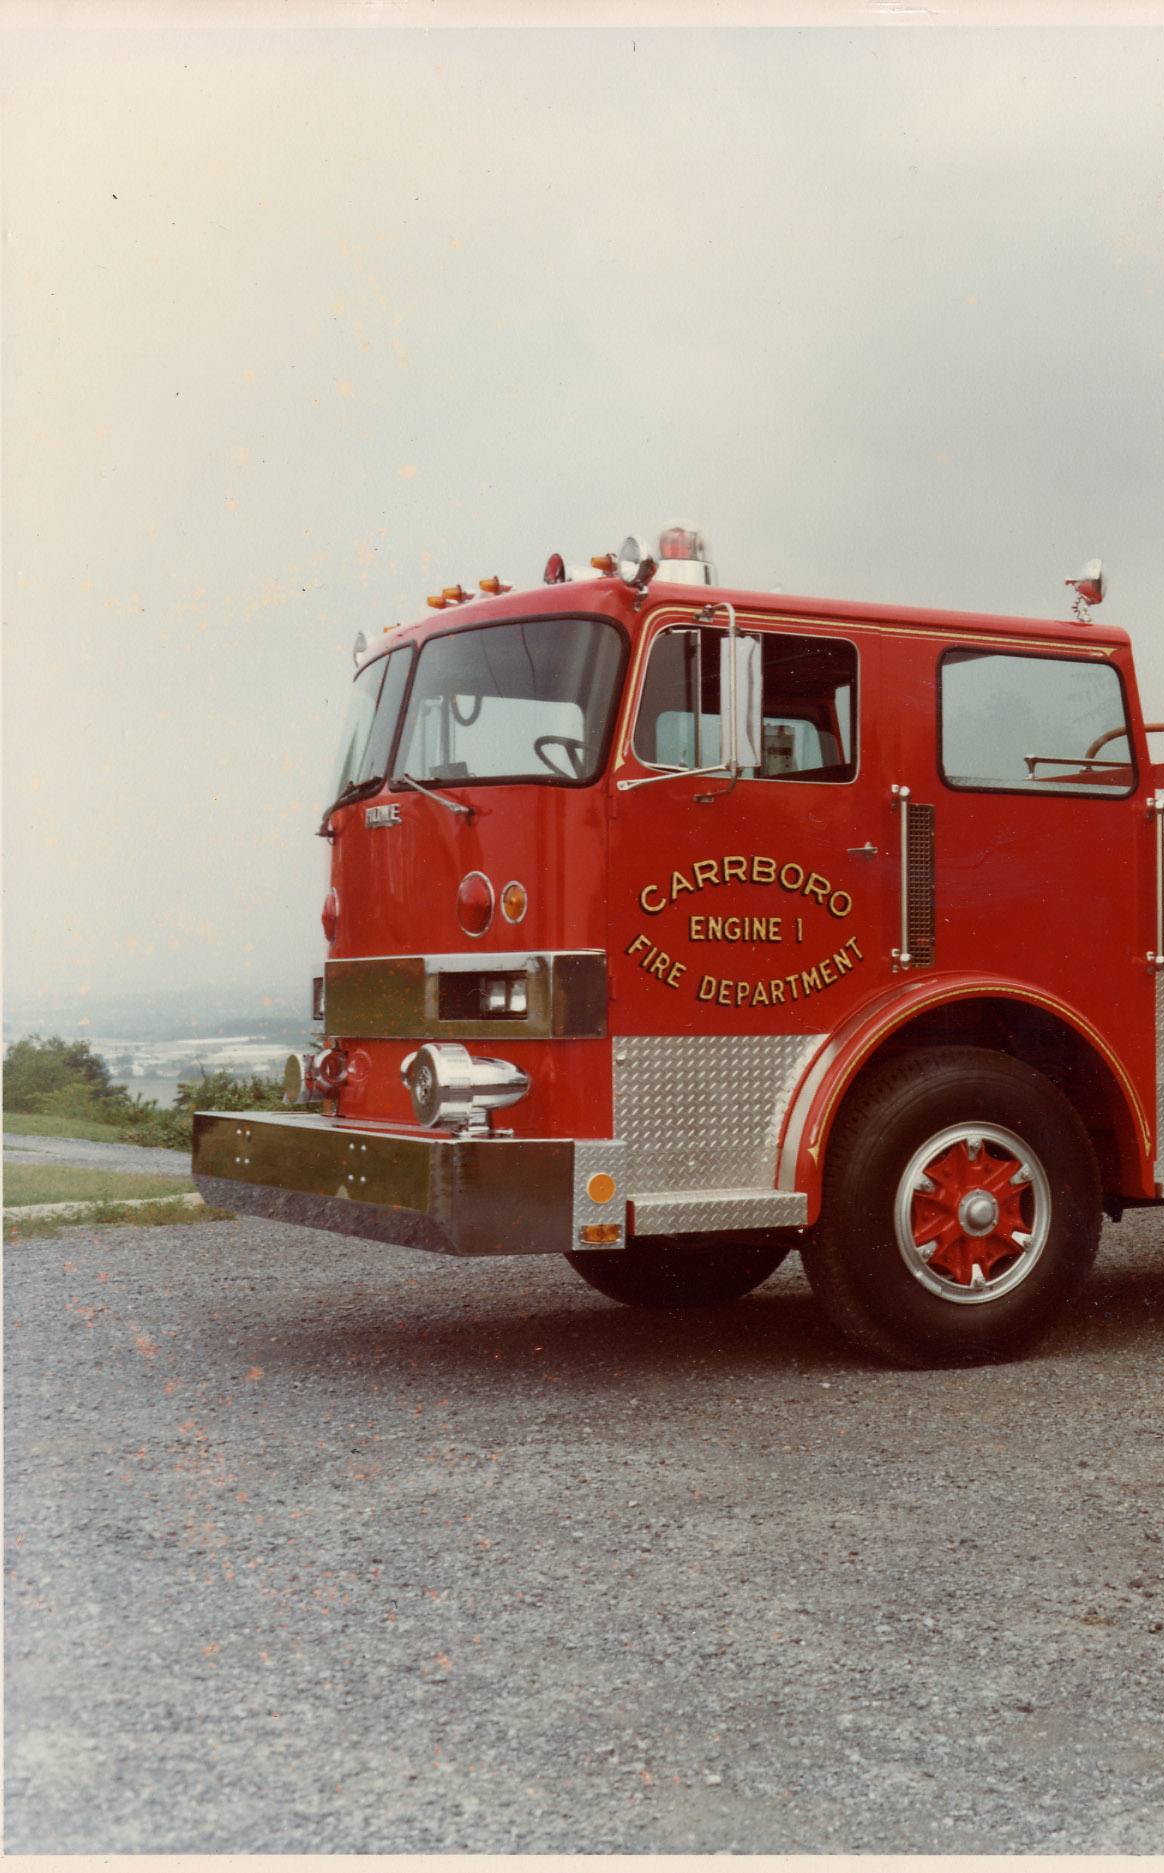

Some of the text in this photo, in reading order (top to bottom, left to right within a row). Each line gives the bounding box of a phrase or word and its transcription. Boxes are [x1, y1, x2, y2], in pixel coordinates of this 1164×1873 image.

[641, 856, 852, 917] CARRBORO
[690, 915, 782, 941] ENGINE
[627, 934, 863, 1006] FIRE DEPARTMENT
